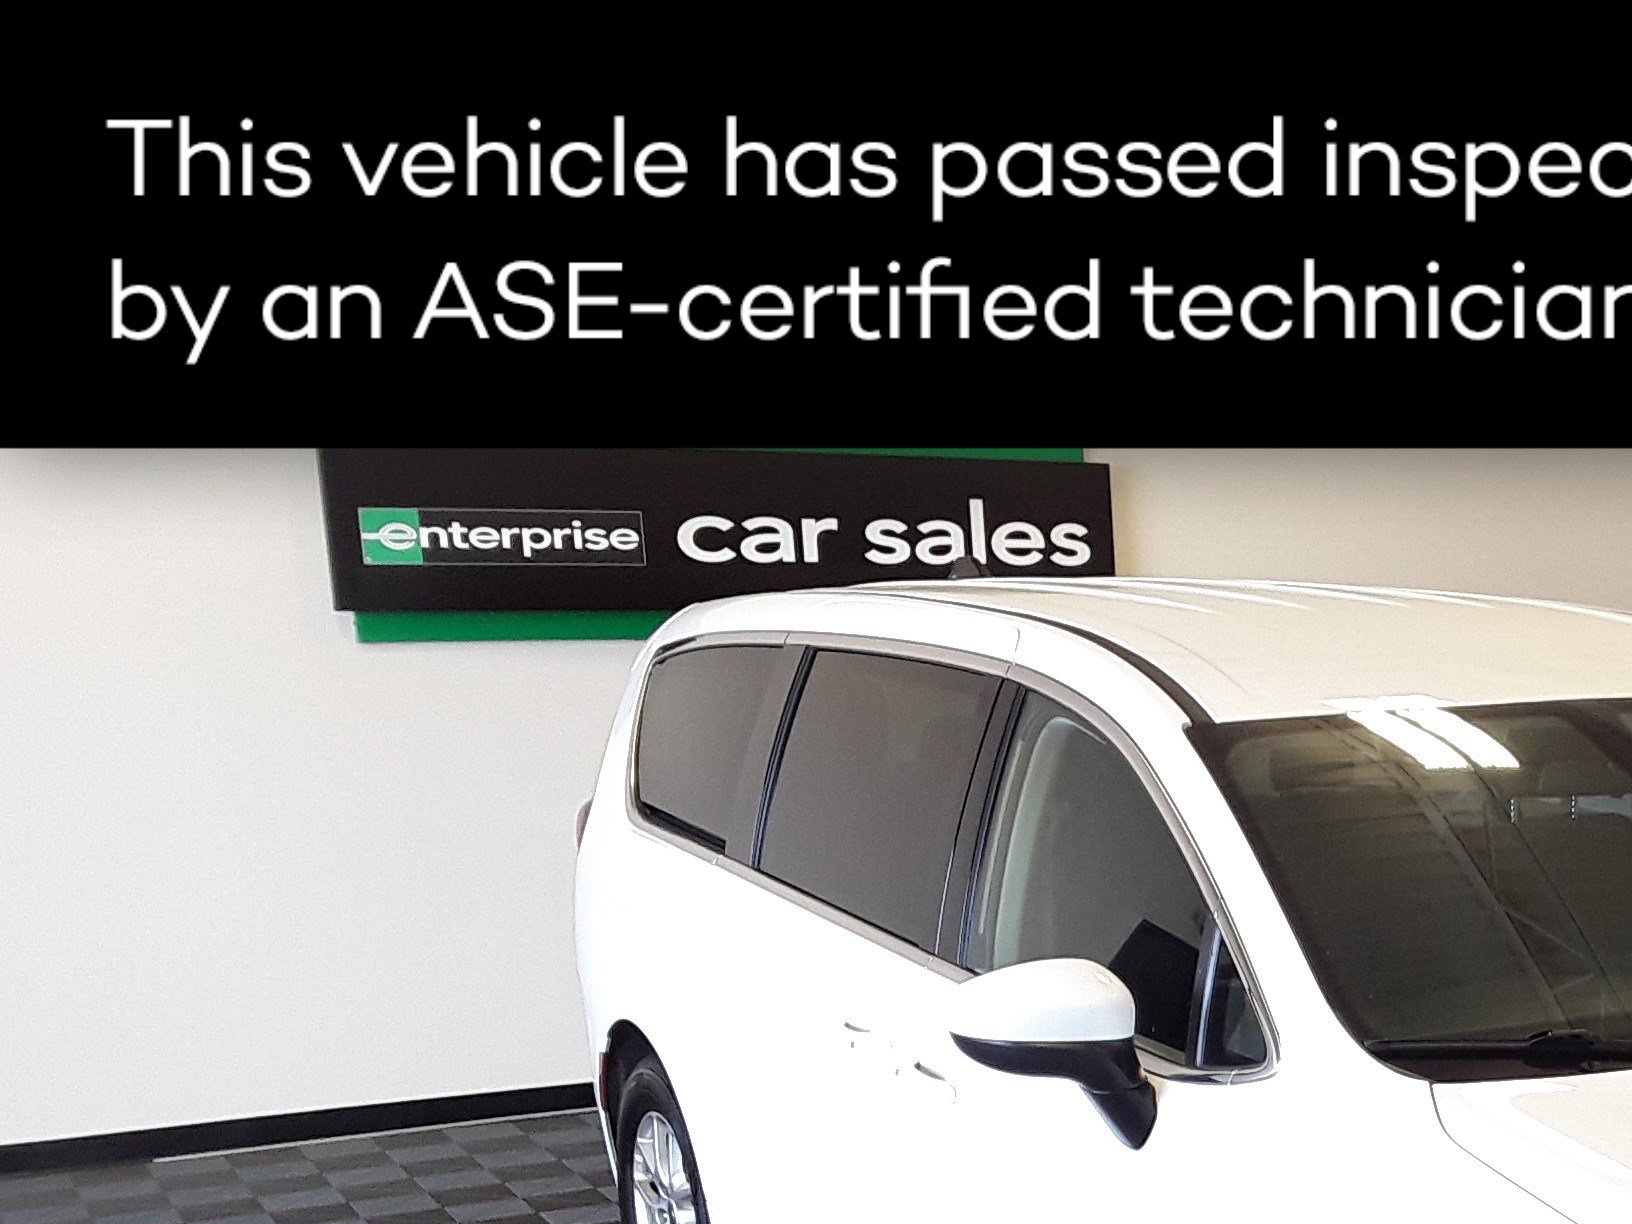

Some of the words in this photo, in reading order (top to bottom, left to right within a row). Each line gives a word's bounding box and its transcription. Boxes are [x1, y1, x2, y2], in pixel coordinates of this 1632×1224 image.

[376, 519, 640, 558] enterprise
[677, 515, 839, 563] car
[864, 498, 1091, 567] sales
